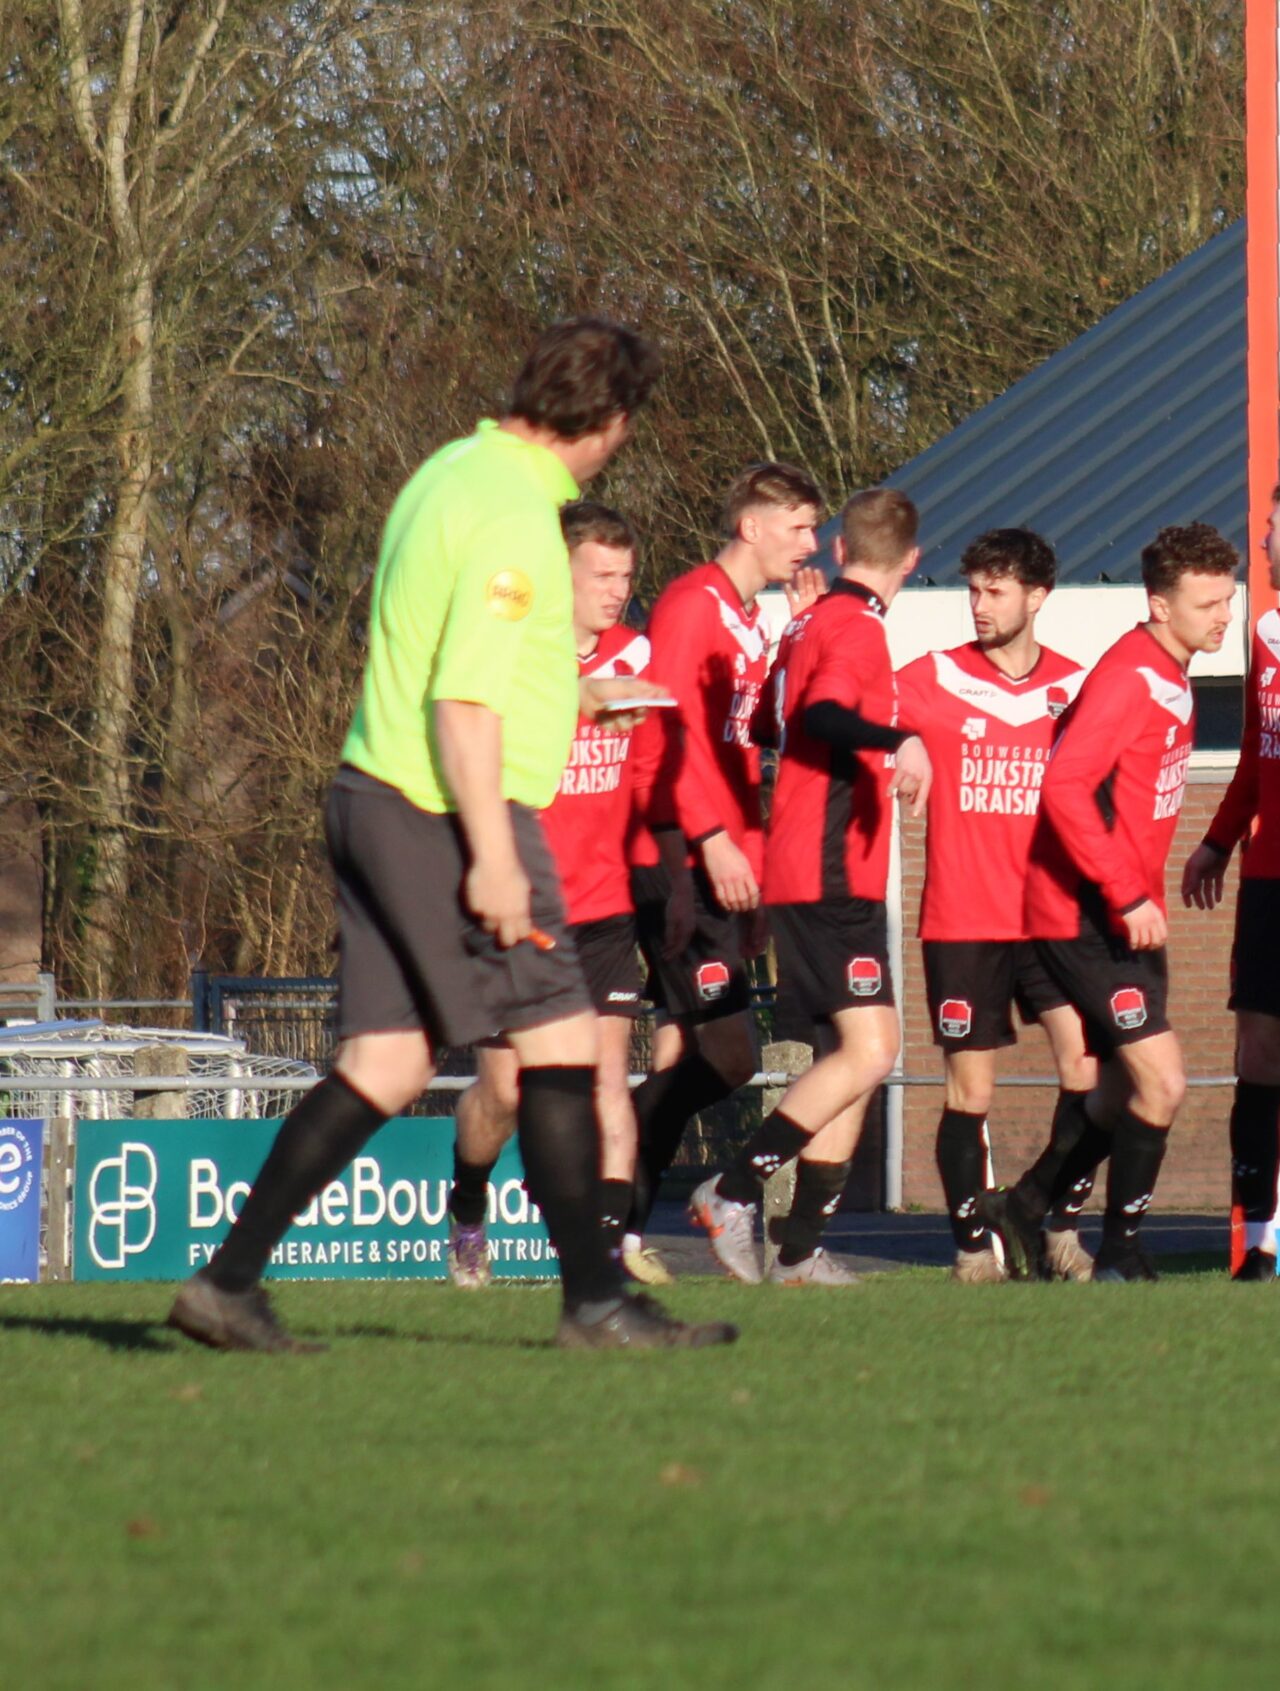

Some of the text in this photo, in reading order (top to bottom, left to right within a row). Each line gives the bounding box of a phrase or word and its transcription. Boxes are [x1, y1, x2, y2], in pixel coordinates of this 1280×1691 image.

[961, 743, 1051, 761] BOUWGRO
[961, 757, 1045, 788] DIJKSTR
[960, 785, 1041, 816] DRAISM
[368, 1241, 382, 1262] &
